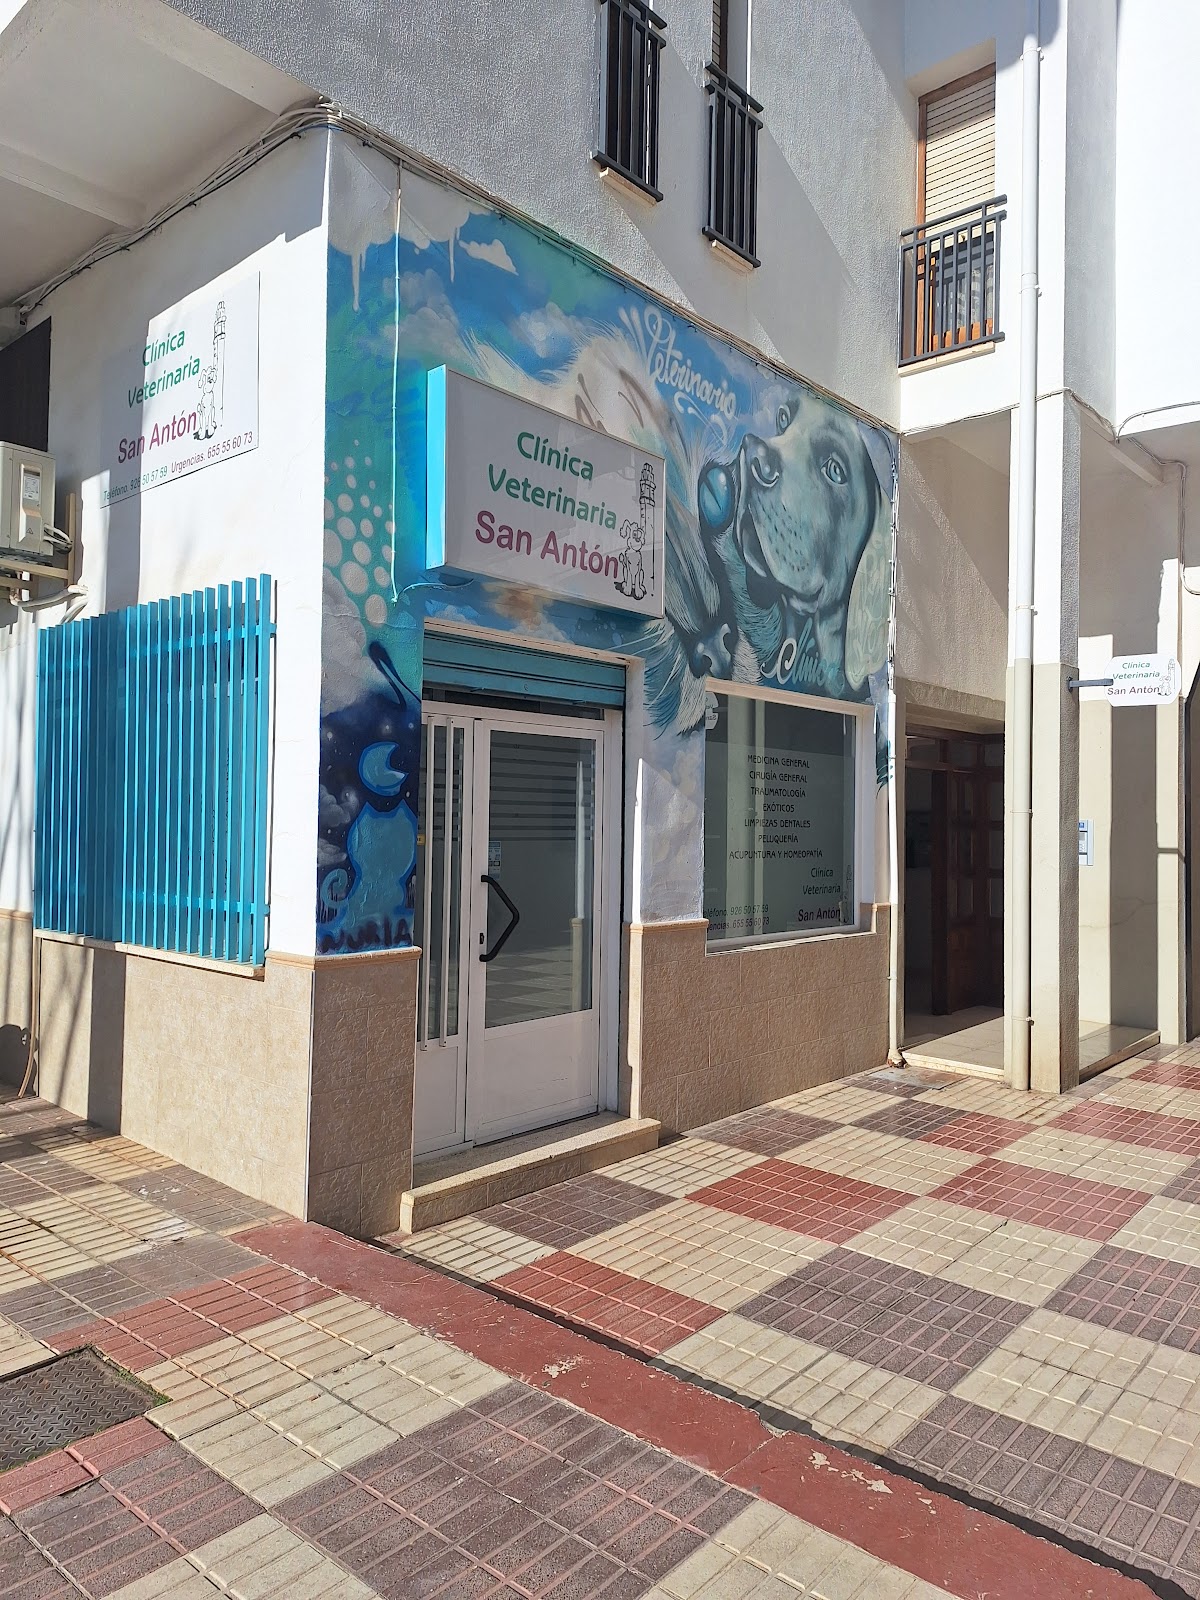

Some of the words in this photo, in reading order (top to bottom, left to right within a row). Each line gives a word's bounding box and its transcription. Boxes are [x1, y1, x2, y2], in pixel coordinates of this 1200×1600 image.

[142, 330, 185, 367] Clínica
[128, 355, 201, 409] Veterinaria
[118, 435, 145, 464] San
[149, 409, 197, 451] Antón
[130, 477, 141, 491] 926
[142, 473, 150, 486] 50
[151, 469, 159, 482] 57
[160, 465, 168, 479] 59
[171, 453, 206, 474] Urgencias.
[207, 443, 221, 459] 655
[222, 439, 231, 453] 55
[232, 435, 242, 450] 60
[243, 431, 253, 446] 73
[517, 431, 594, 481] Clínica
[488, 463, 617, 530] Veterinaria
[475, 510, 532, 556] San
[540, 530, 620, 579] Antón
[1122, 661, 1151, 669] Clínica
[1112, 670, 1160, 680] Veterinaria
[1107, 687, 1126, 696] San
[1129, 685, 1160, 695] Antón
[747, 754, 779, 766] MEDICINA
[781, 757, 810, 769] GENERAL
[749, 769, 777, 781] CIRUGÍA
[779, 773, 808, 784] GENERAL
[750, 786, 806, 798] TRAUMATOLOGÍA
[762, 801, 795, 813] EXÓTICOS
[744, 818, 778, 828] LIMPIEZAS
[780, 819, 811, 828] DENTALES
[758, 833, 799, 845] PELUQUERÍA
[728, 850, 776, 860] ACUPUNTURA
[777, 850, 782, 859] Y
[783, 848, 823, 859] HOMEOPATÍA
[810, 866, 834, 878] Clínica
[802, 883, 841, 895] Veterinaria
[703, 907, 728, 918] eléfono.
[730, 905, 742, 916] 926
[743, 904, 752, 915] 50
[798, 908, 814, 922] San
[816, 906, 841, 920] Antón
[732, 919, 744, 929] 655
[762, 916, 770, 926] 73
